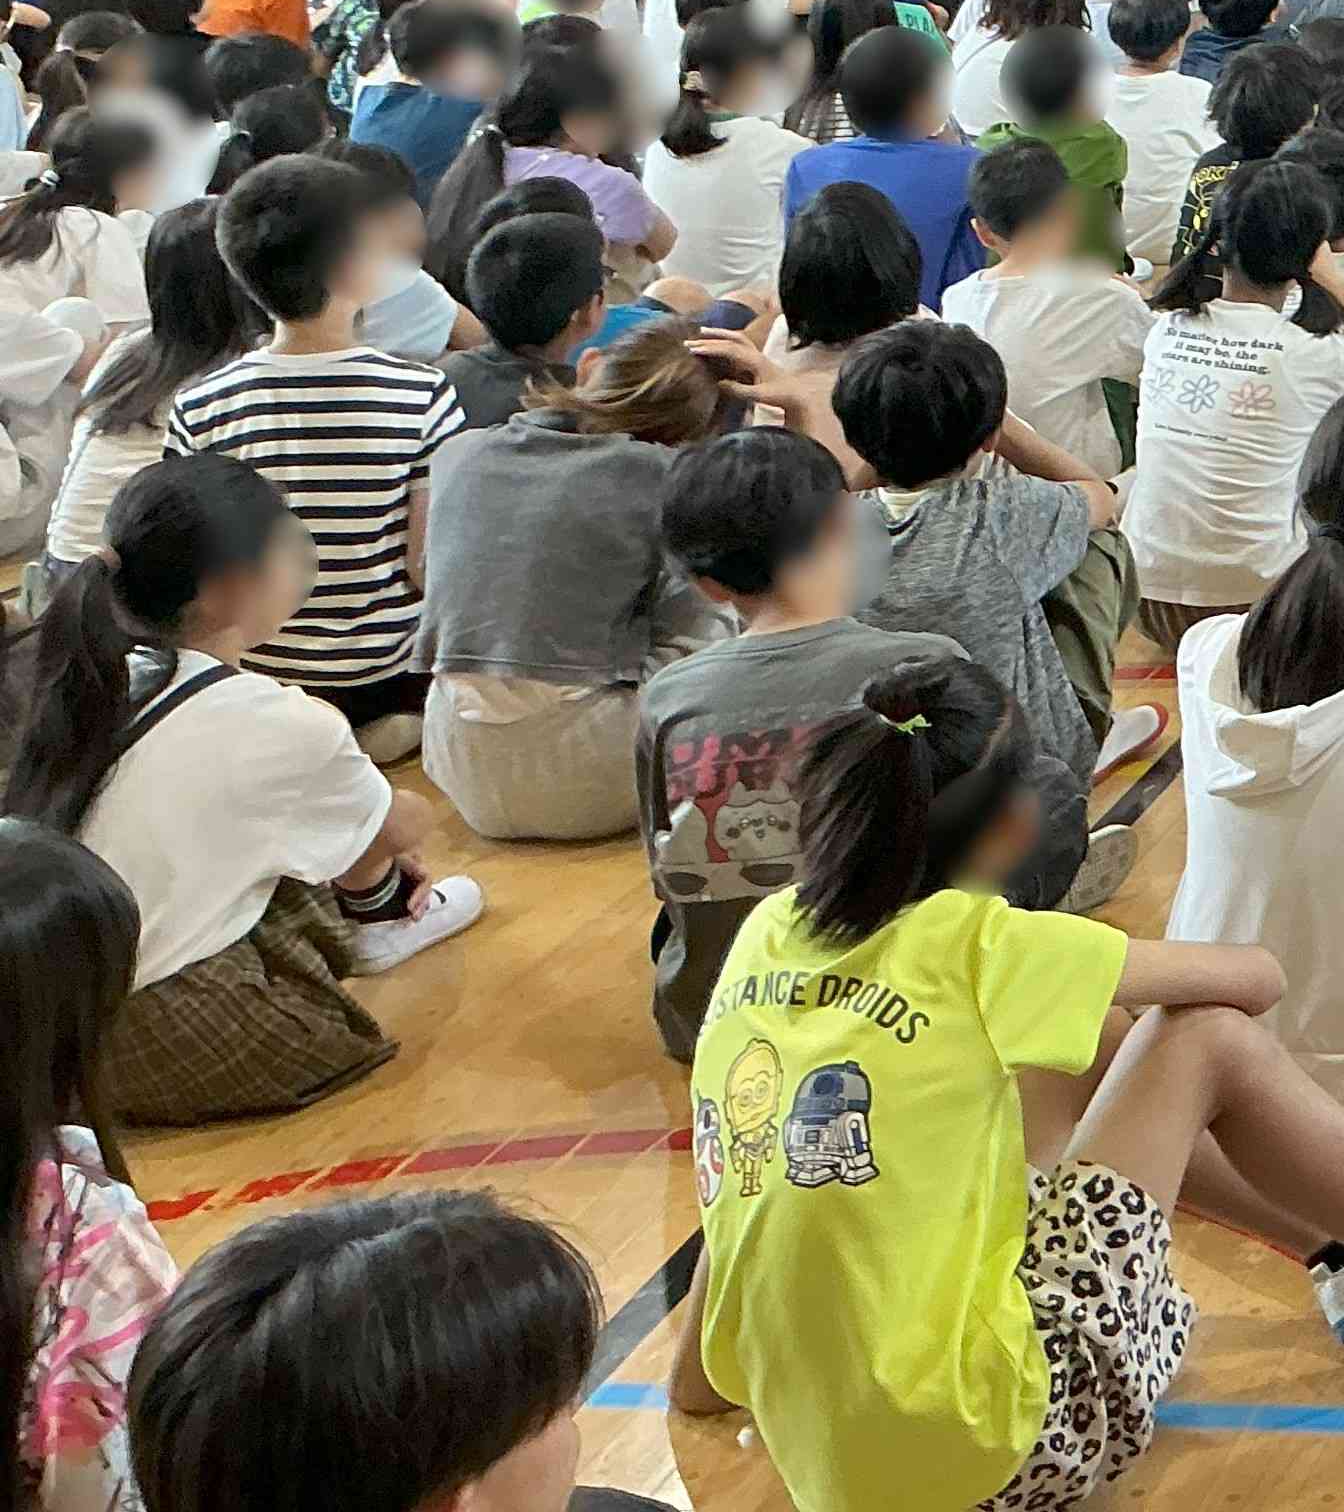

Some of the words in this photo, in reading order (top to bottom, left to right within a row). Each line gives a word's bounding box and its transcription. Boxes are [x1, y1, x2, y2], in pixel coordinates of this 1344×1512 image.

[1221, 338, 1248, 348] how
[1251, 339, 1284, 352] dark
[1235, 350, 1258, 361] the
[704, 970, 810, 1023] STANCE
[815, 973, 931, 1045] DROIDS
